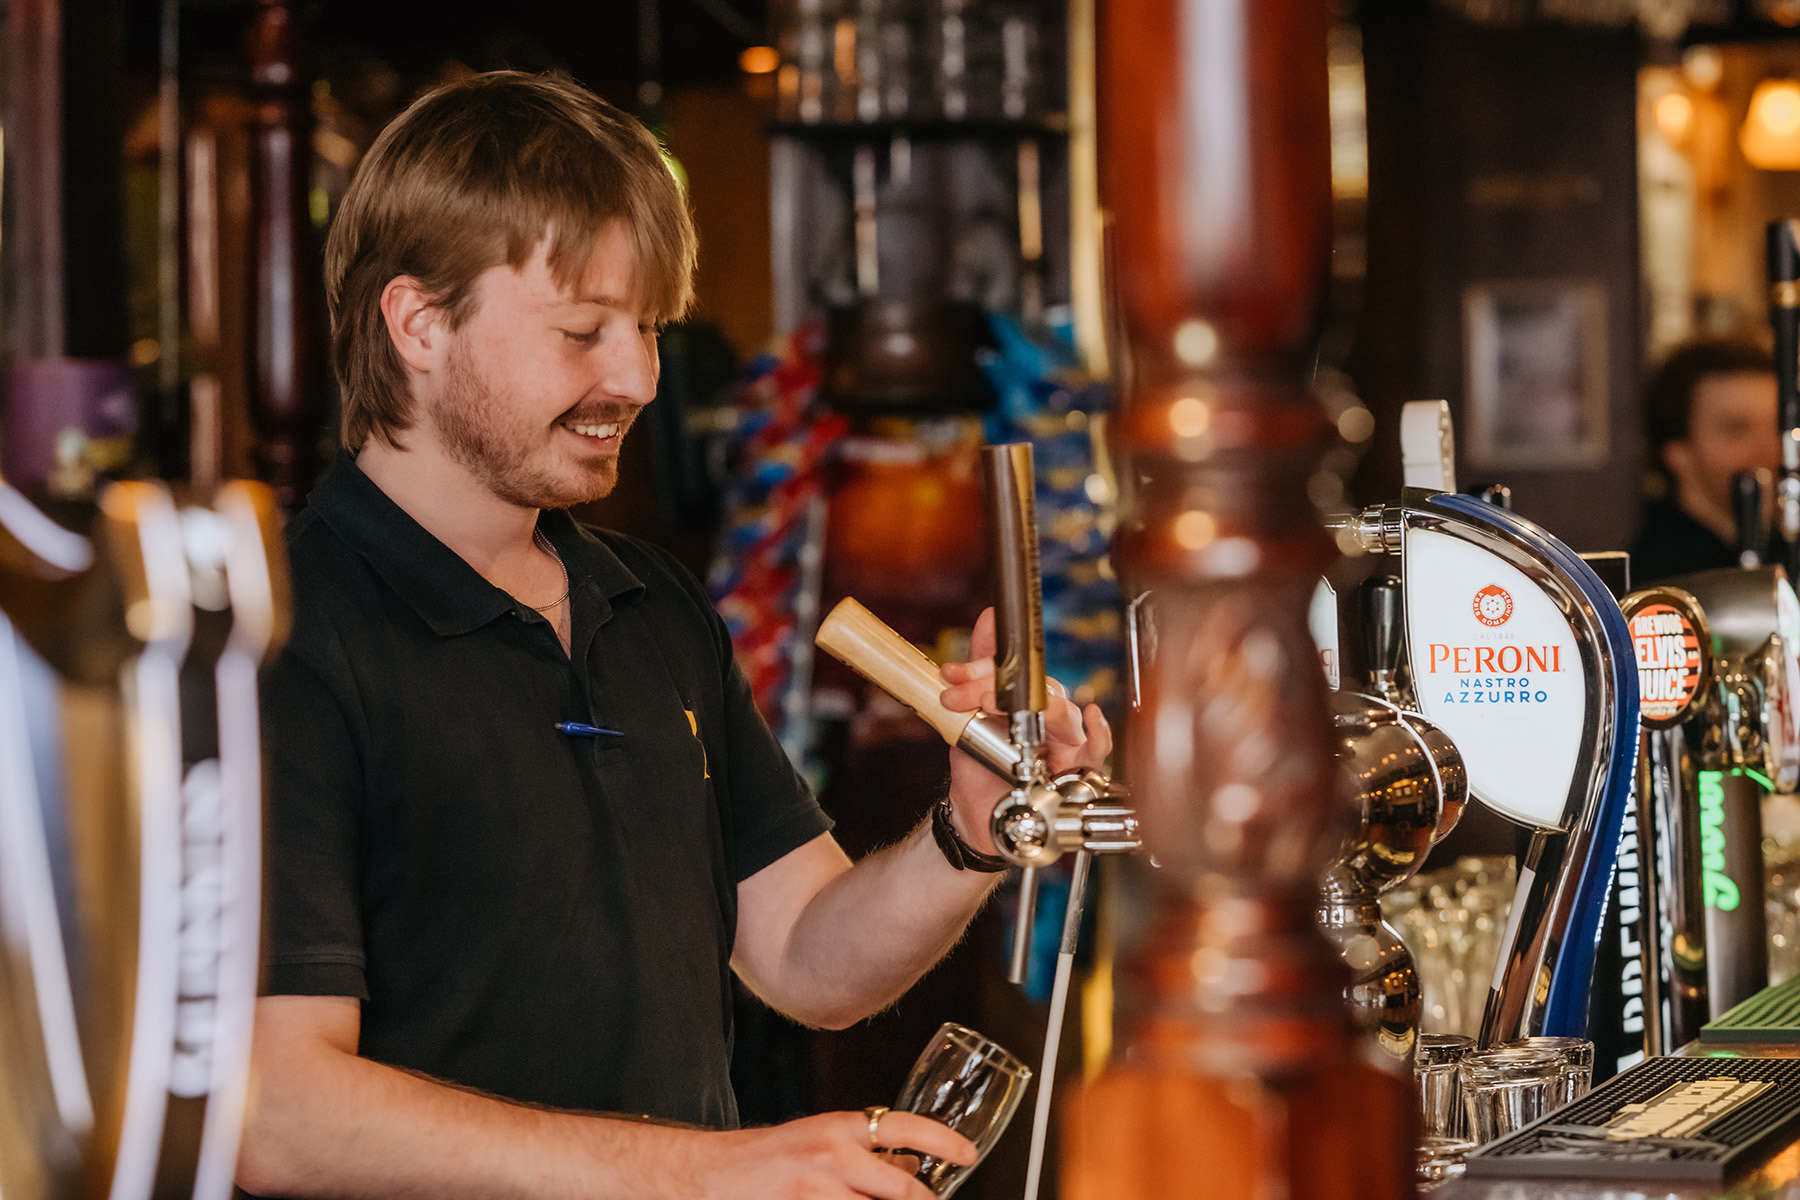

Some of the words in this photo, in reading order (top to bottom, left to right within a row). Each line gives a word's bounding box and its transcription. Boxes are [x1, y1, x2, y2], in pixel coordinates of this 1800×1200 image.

[1482, 617, 1505, 626] ROMA
[1473, 633, 1490, 641] DAL
[1494, 633, 1516, 641] 1846
[1429, 643, 1561, 673] PERONI
[1635, 635, 1687, 669] ELVIS
[1460, 677, 1530, 688] NASTRO
[1443, 690, 1548, 703] AZZURRO
